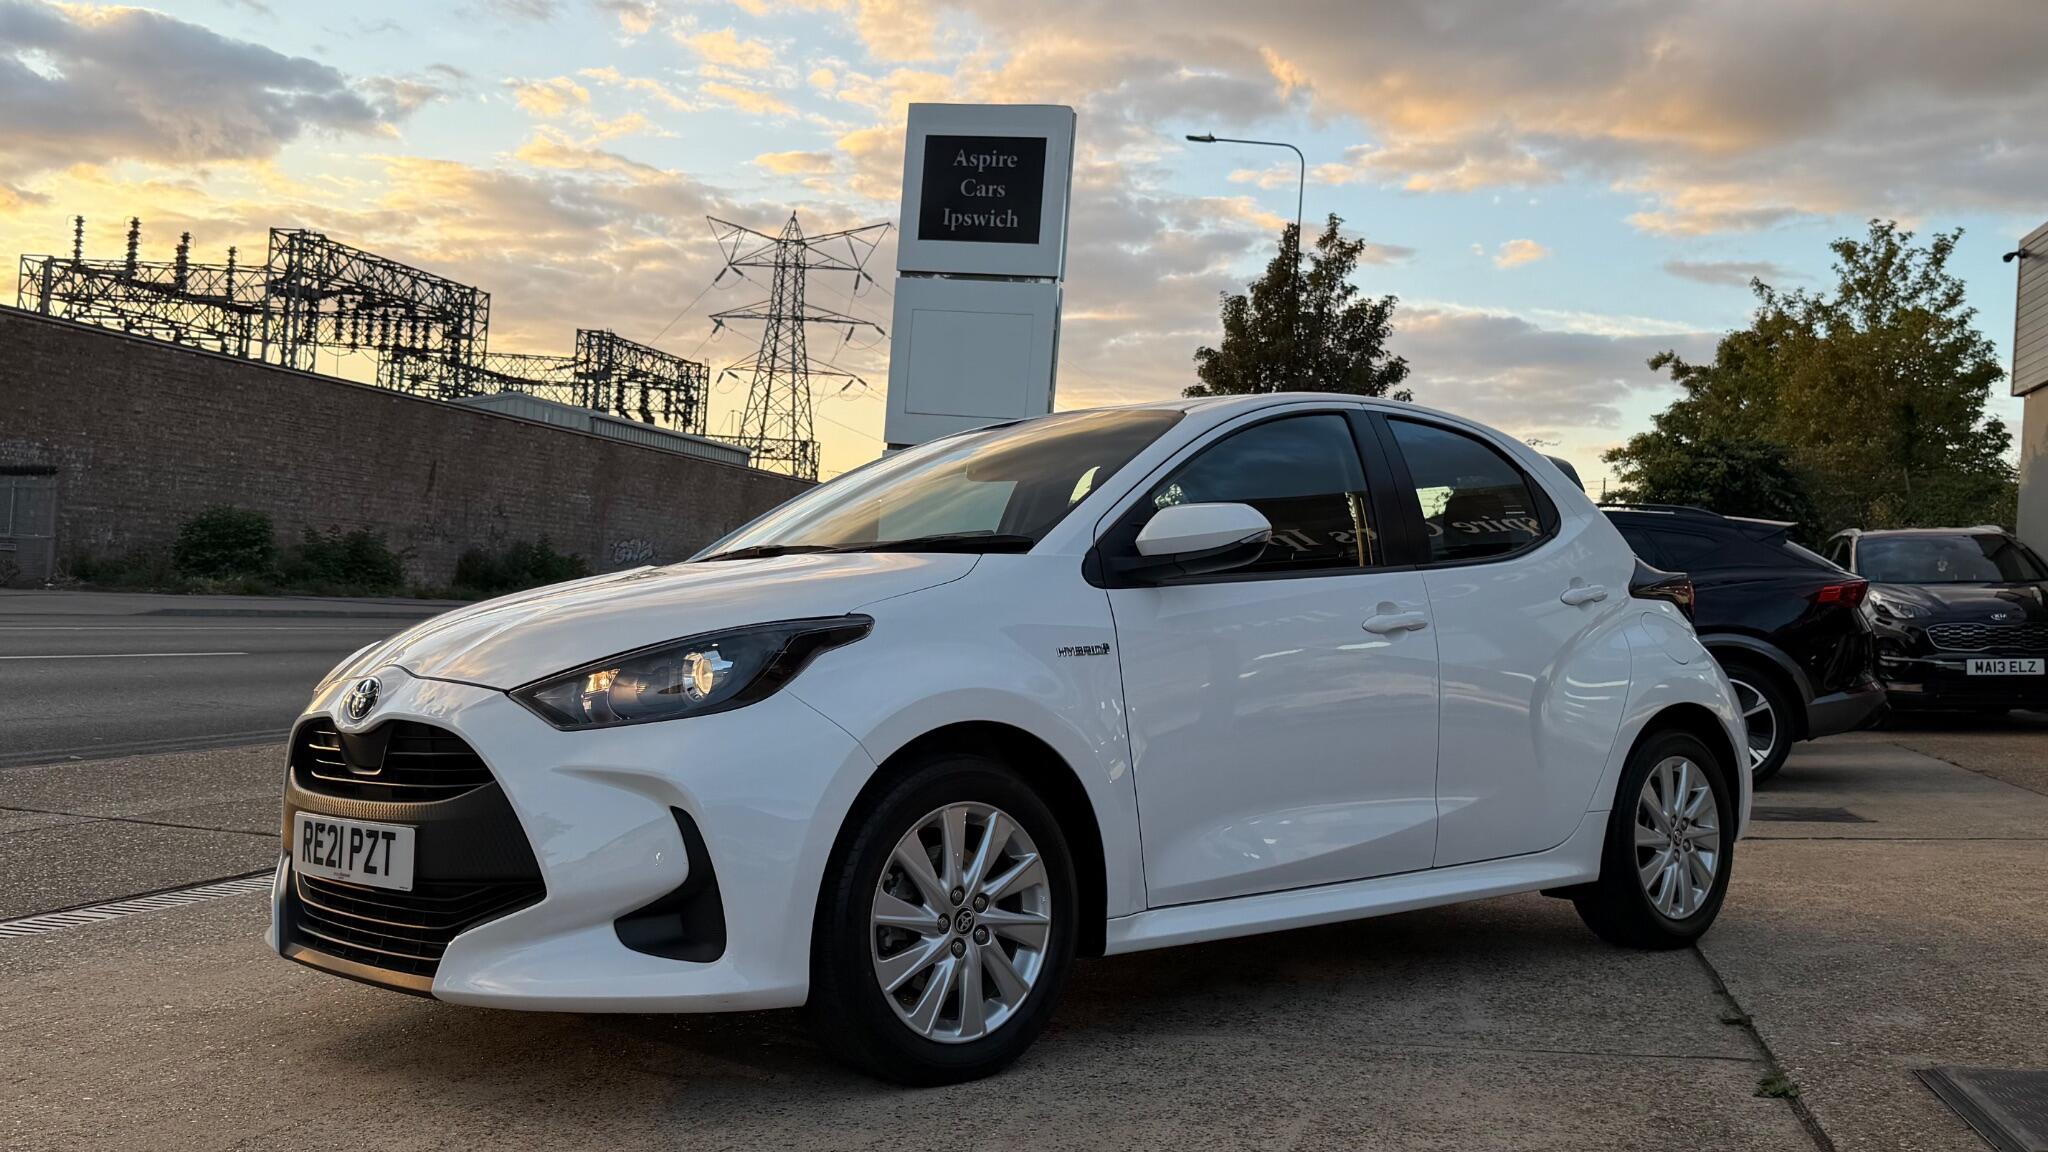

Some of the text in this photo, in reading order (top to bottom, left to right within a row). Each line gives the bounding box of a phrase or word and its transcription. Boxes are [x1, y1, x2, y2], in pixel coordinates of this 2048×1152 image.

[953, 148, 1018, 173] Aspire
[960, 178, 1006, 198] Cars
[943, 207, 1019, 231] Ipswich
[1056, 645, 1104, 657] HYBRID
[1974, 660, 2037, 673] MA13 ELZ
[302, 820, 397, 876] RE21 PZT
